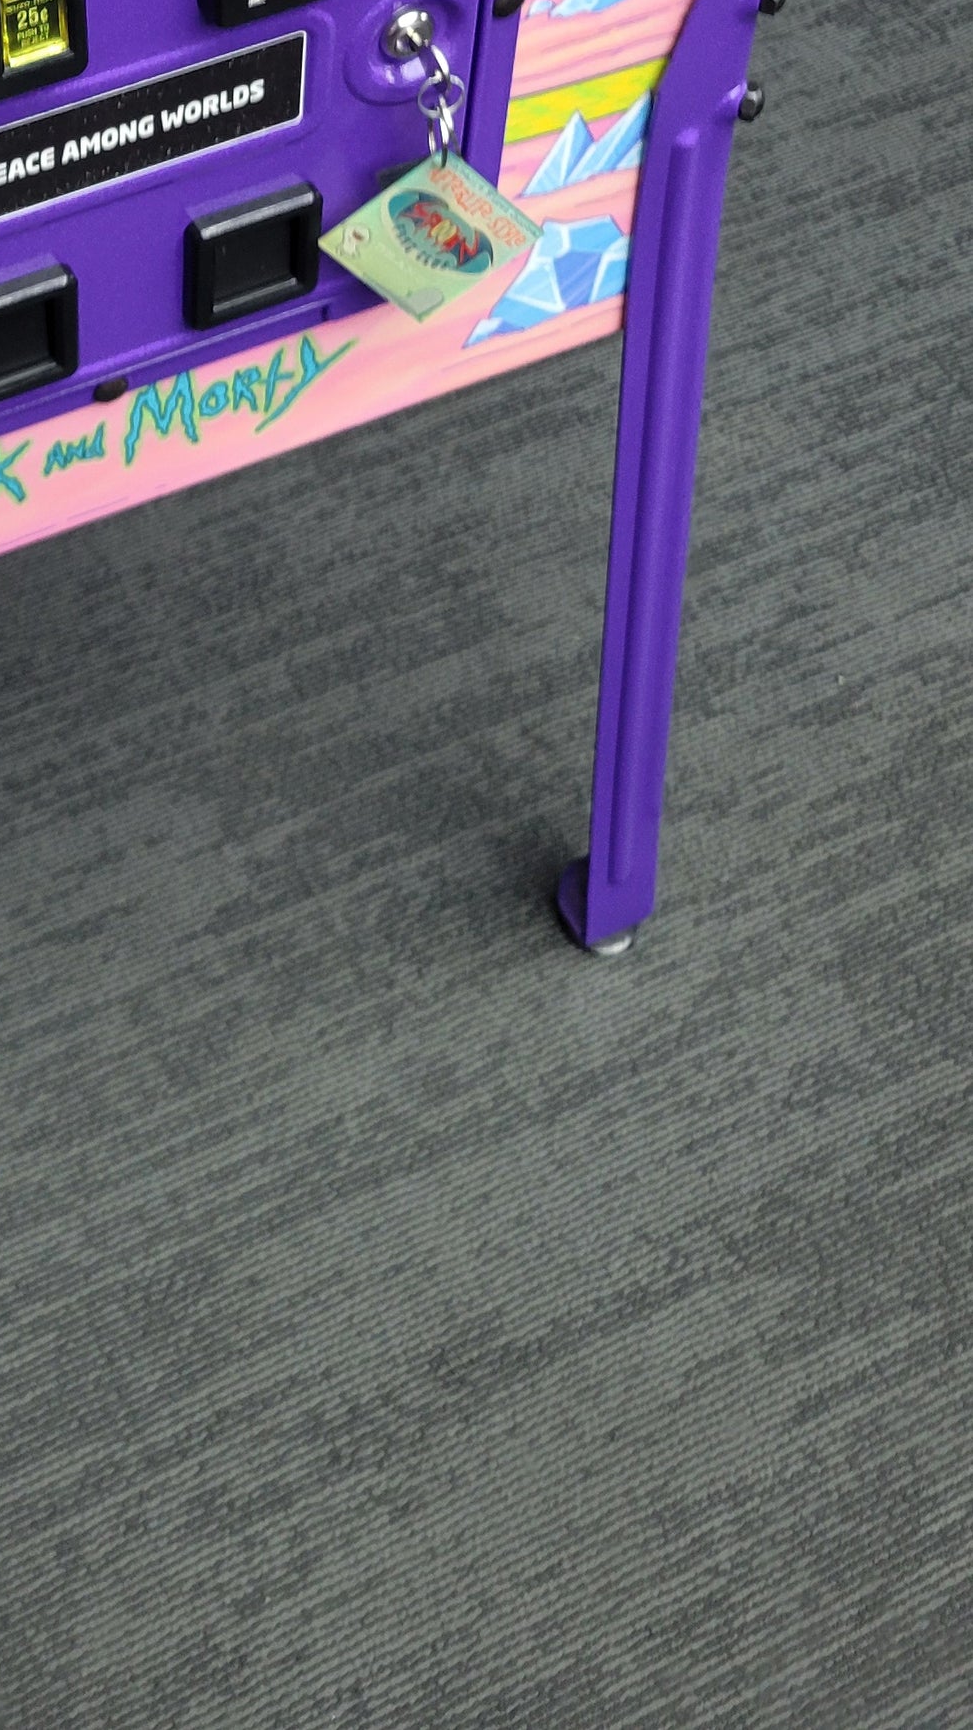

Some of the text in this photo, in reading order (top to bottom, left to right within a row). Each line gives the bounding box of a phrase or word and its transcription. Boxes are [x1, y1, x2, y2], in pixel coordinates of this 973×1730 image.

[16, 6, 49, 31] 25¢
[60, 114, 155, 166] AMONG
[160, 78, 266, 134] WORLDS
[43, 421, 107, 477] and
[124, 334, 360, 466] Morty
